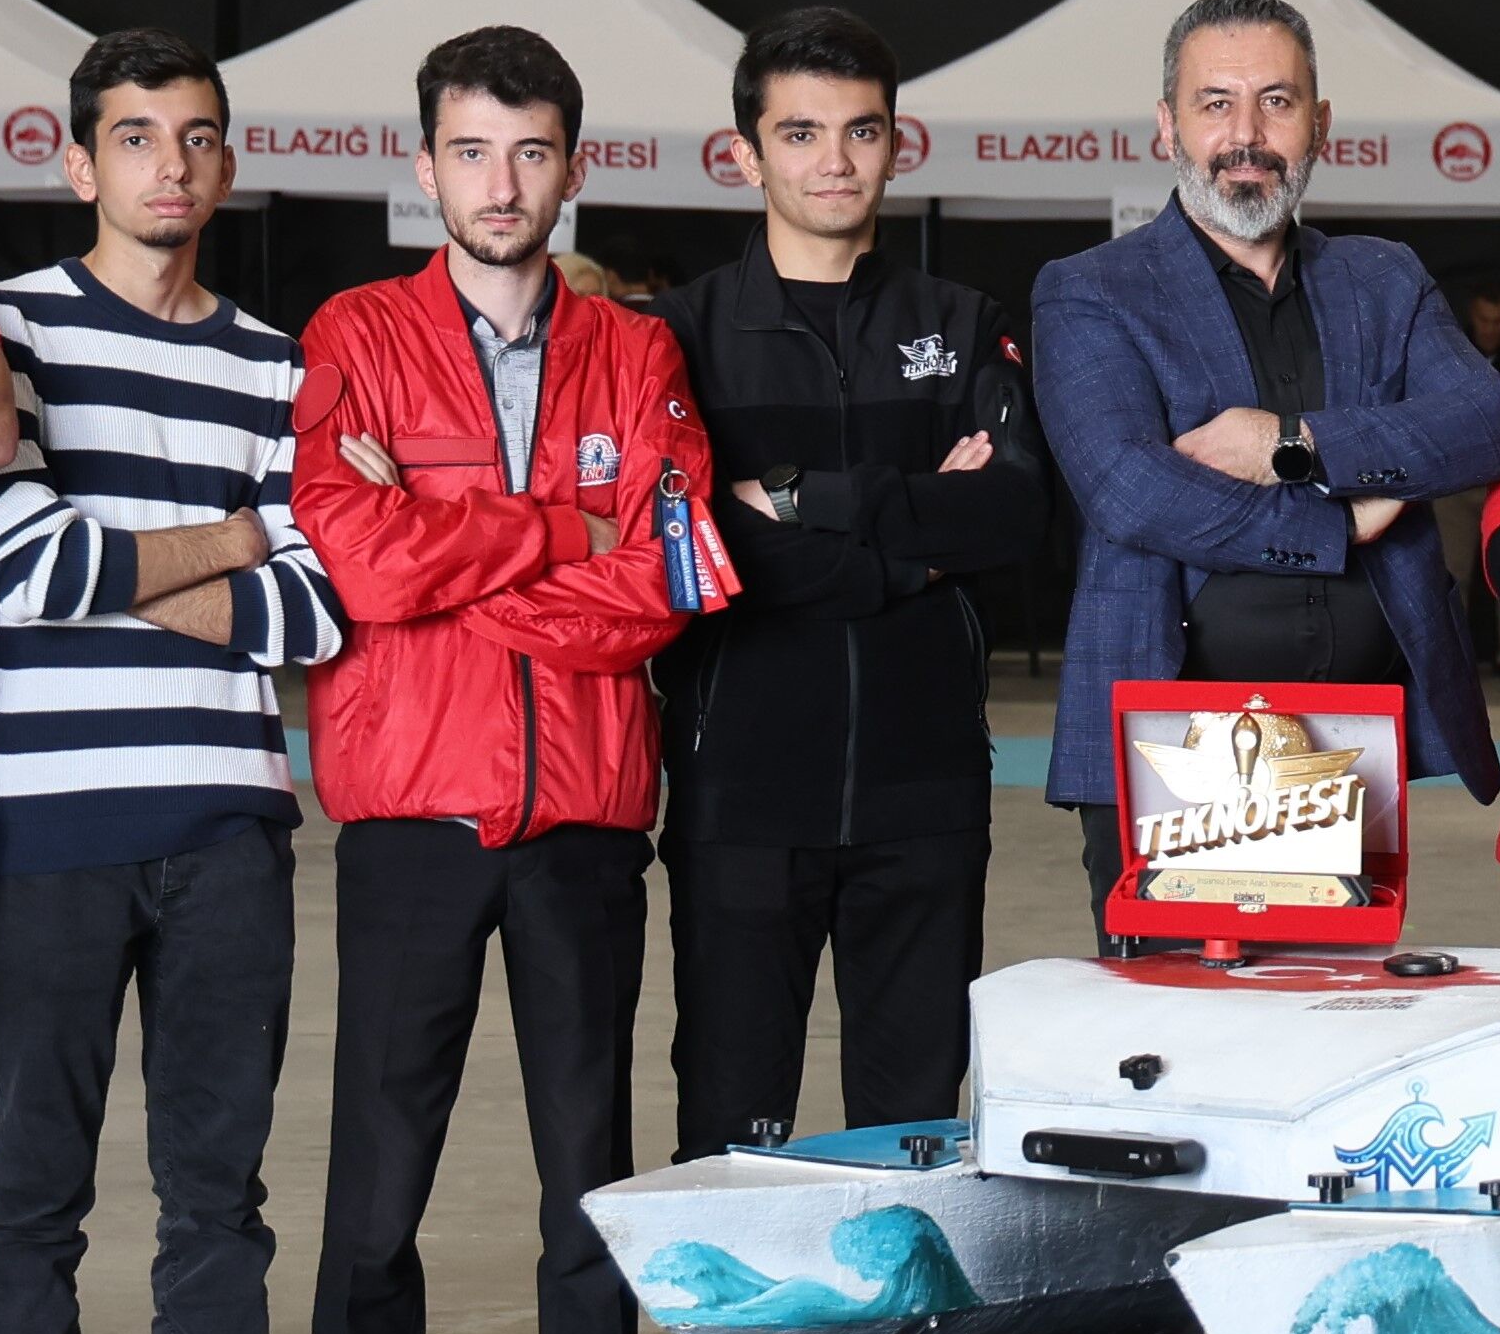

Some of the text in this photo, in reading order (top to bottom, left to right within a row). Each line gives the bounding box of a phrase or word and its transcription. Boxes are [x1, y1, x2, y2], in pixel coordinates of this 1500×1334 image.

[245, 124, 659, 170] ELAZIĞ İL RESİ
[976, 129, 1100, 163] ELAZIĞ
[1112, 129, 1140, 161] İL
[1320, 133, 1389, 167] RESİ
[1136, 774, 1365, 862] TEKNOFEST
